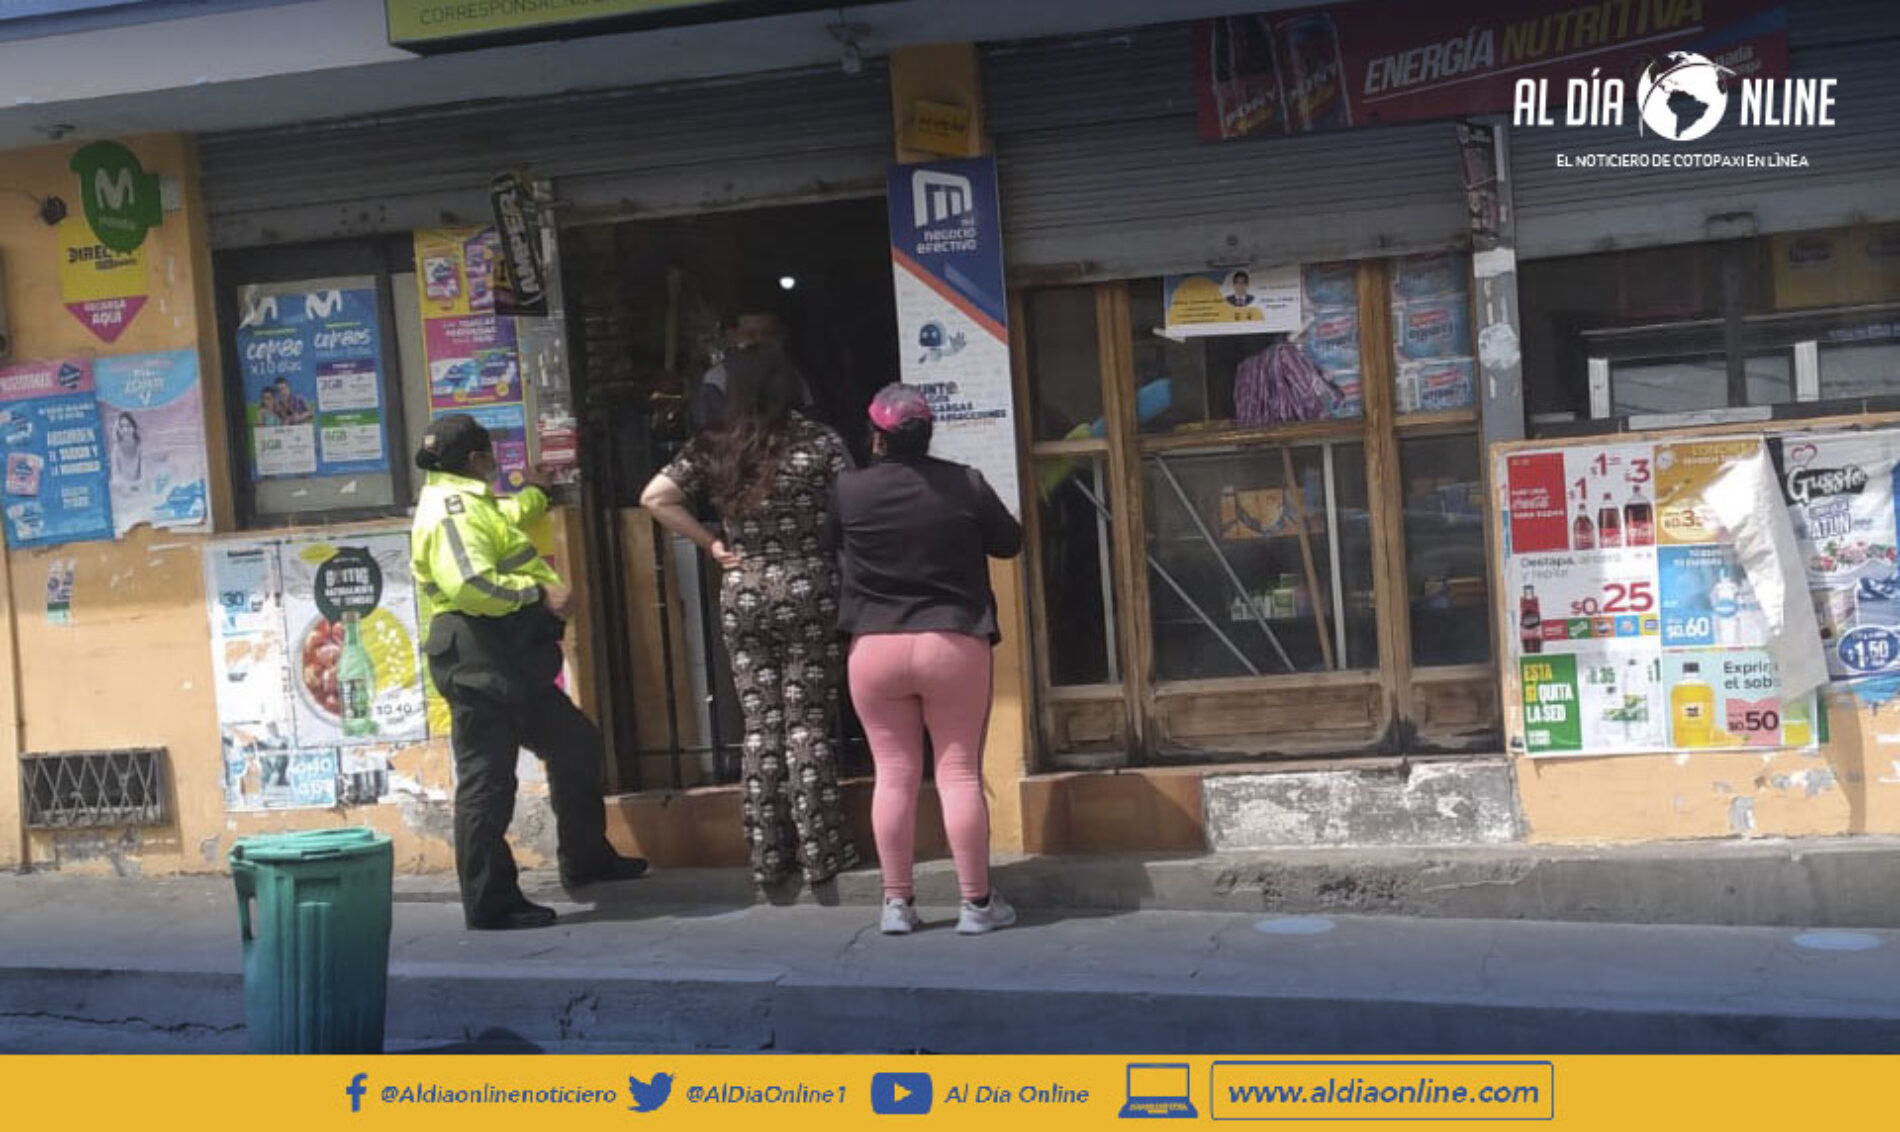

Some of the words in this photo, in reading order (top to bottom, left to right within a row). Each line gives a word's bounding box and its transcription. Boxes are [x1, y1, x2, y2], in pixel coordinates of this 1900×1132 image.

[1364, 28, 1494, 95] ENERGÍA
[1502, 0, 1703, 62] NUTRITIVA
[1725, 677, 1739, 689] el
